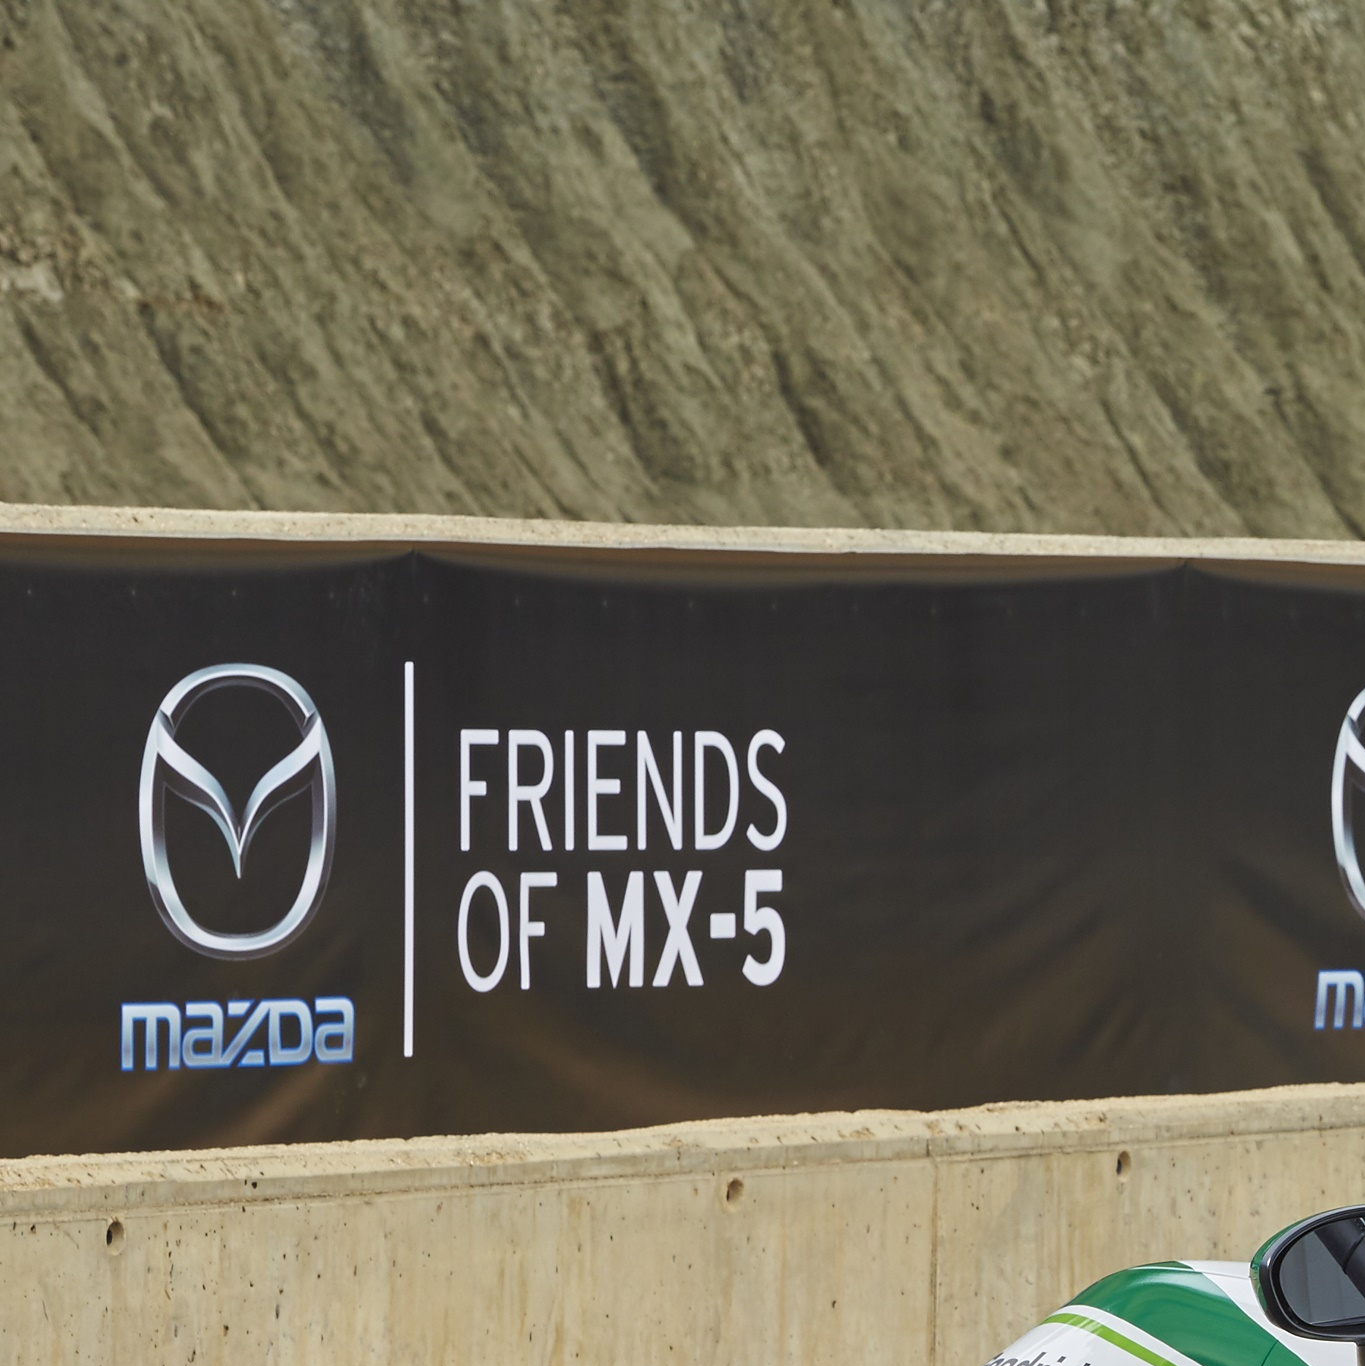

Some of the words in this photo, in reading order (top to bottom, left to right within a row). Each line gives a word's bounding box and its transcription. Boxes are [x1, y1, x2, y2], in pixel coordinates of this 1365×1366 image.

[460, 728, 788, 852] FRIENDS
[457, 870, 558, 993] OF
[586, 868, 787, 989] MX-5
